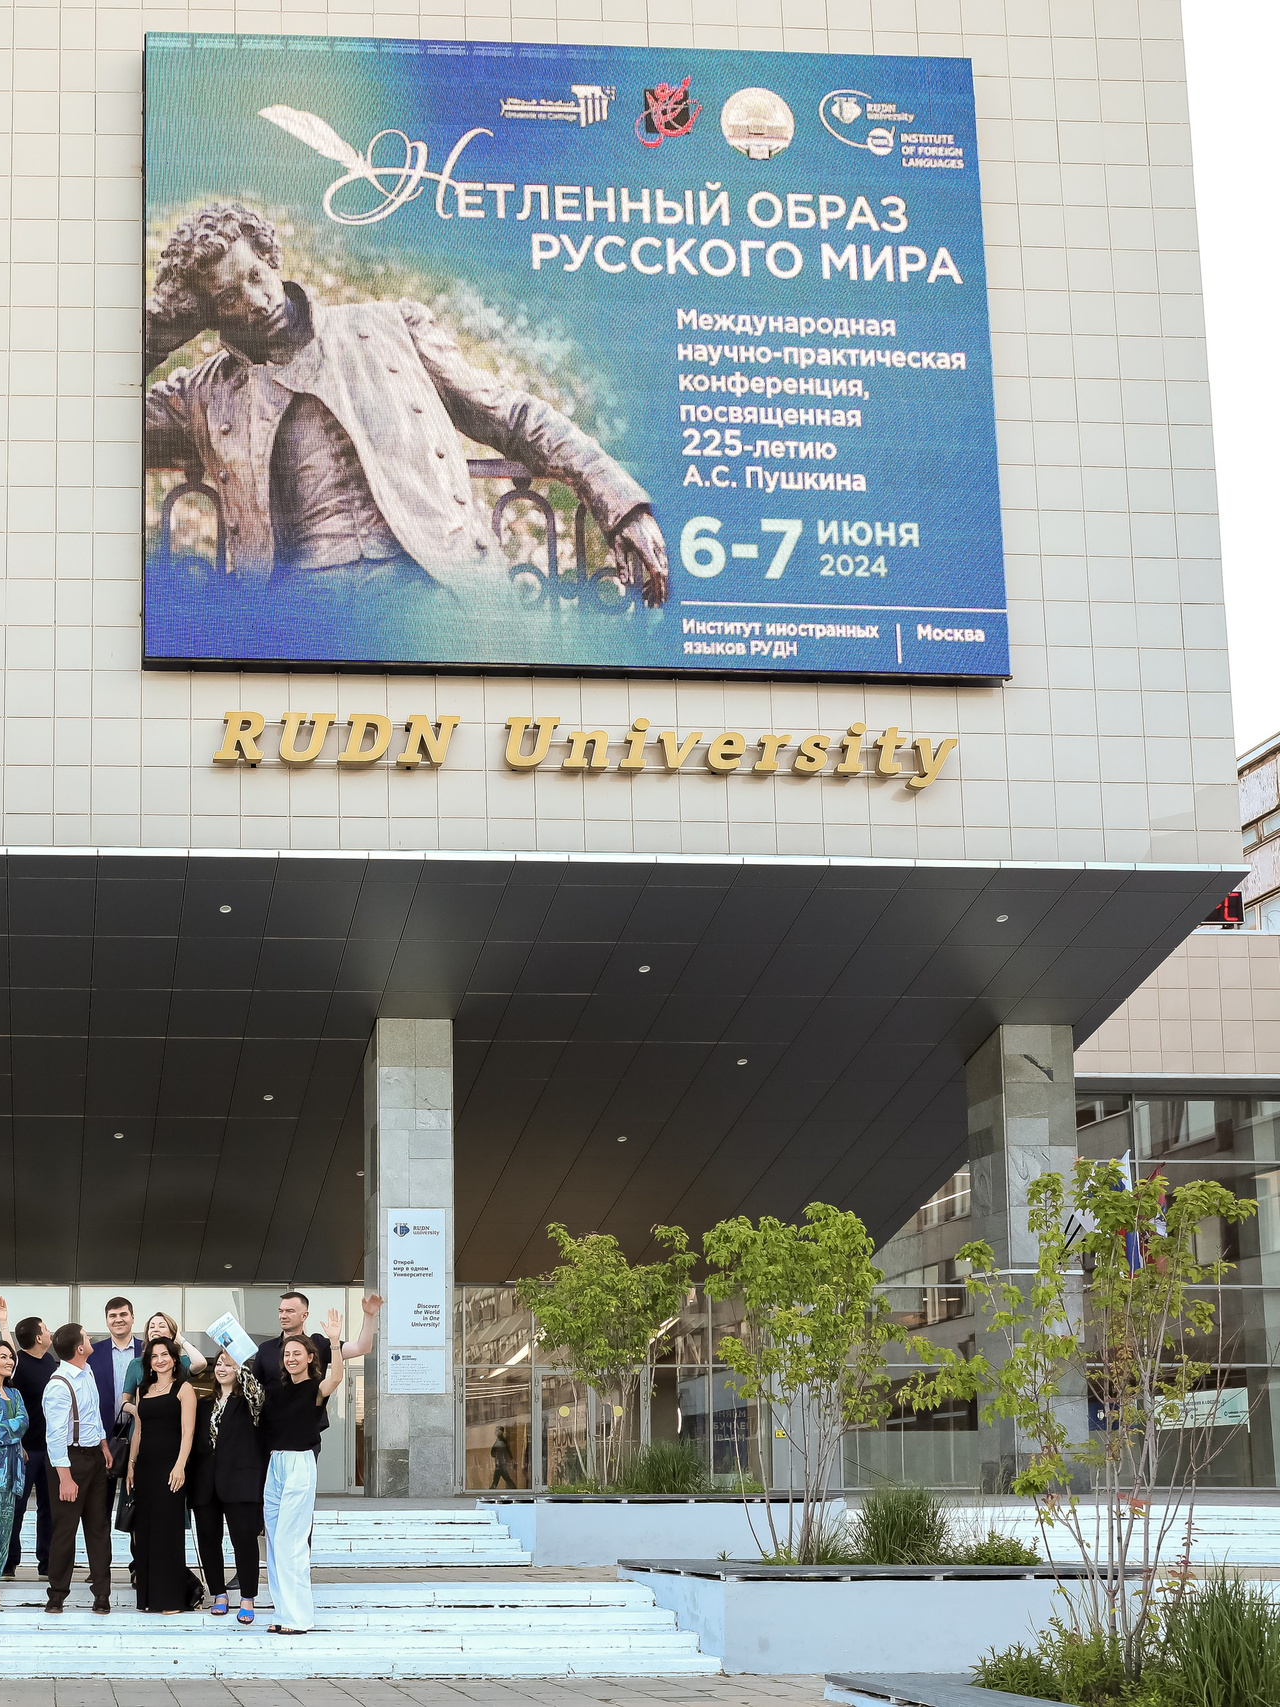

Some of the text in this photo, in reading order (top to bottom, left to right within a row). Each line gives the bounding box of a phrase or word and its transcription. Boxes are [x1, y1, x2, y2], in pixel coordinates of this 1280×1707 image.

[900, 133, 955, 144] INSTITUTE
[901, 145, 963, 157] OF FOREIGN
[901, 157, 964, 169] LANGUAGES
[747, 190, 909, 235] ОБРАЗ
[532, 232, 964, 285] РУССКОГО МИРА
[676, 308, 897, 338] Международная
[677, 343, 967, 371] научно-практическая
[678, 371, 870, 400] конференция,
[679, 404, 862, 429] посвященная
[681, 427, 838, 461] 225-летию
[682, 464, 867, 494] А.С. Пушкина
[679, 515, 803, 580] 6-7
[819, 553, 889, 578] 2024
[682, 617, 880, 640] Институт иностранных
[916, 623, 986, 643] Москва
[683, 640, 798, 659] языков РУДН
[212, 710, 958, 791] RUDN University
